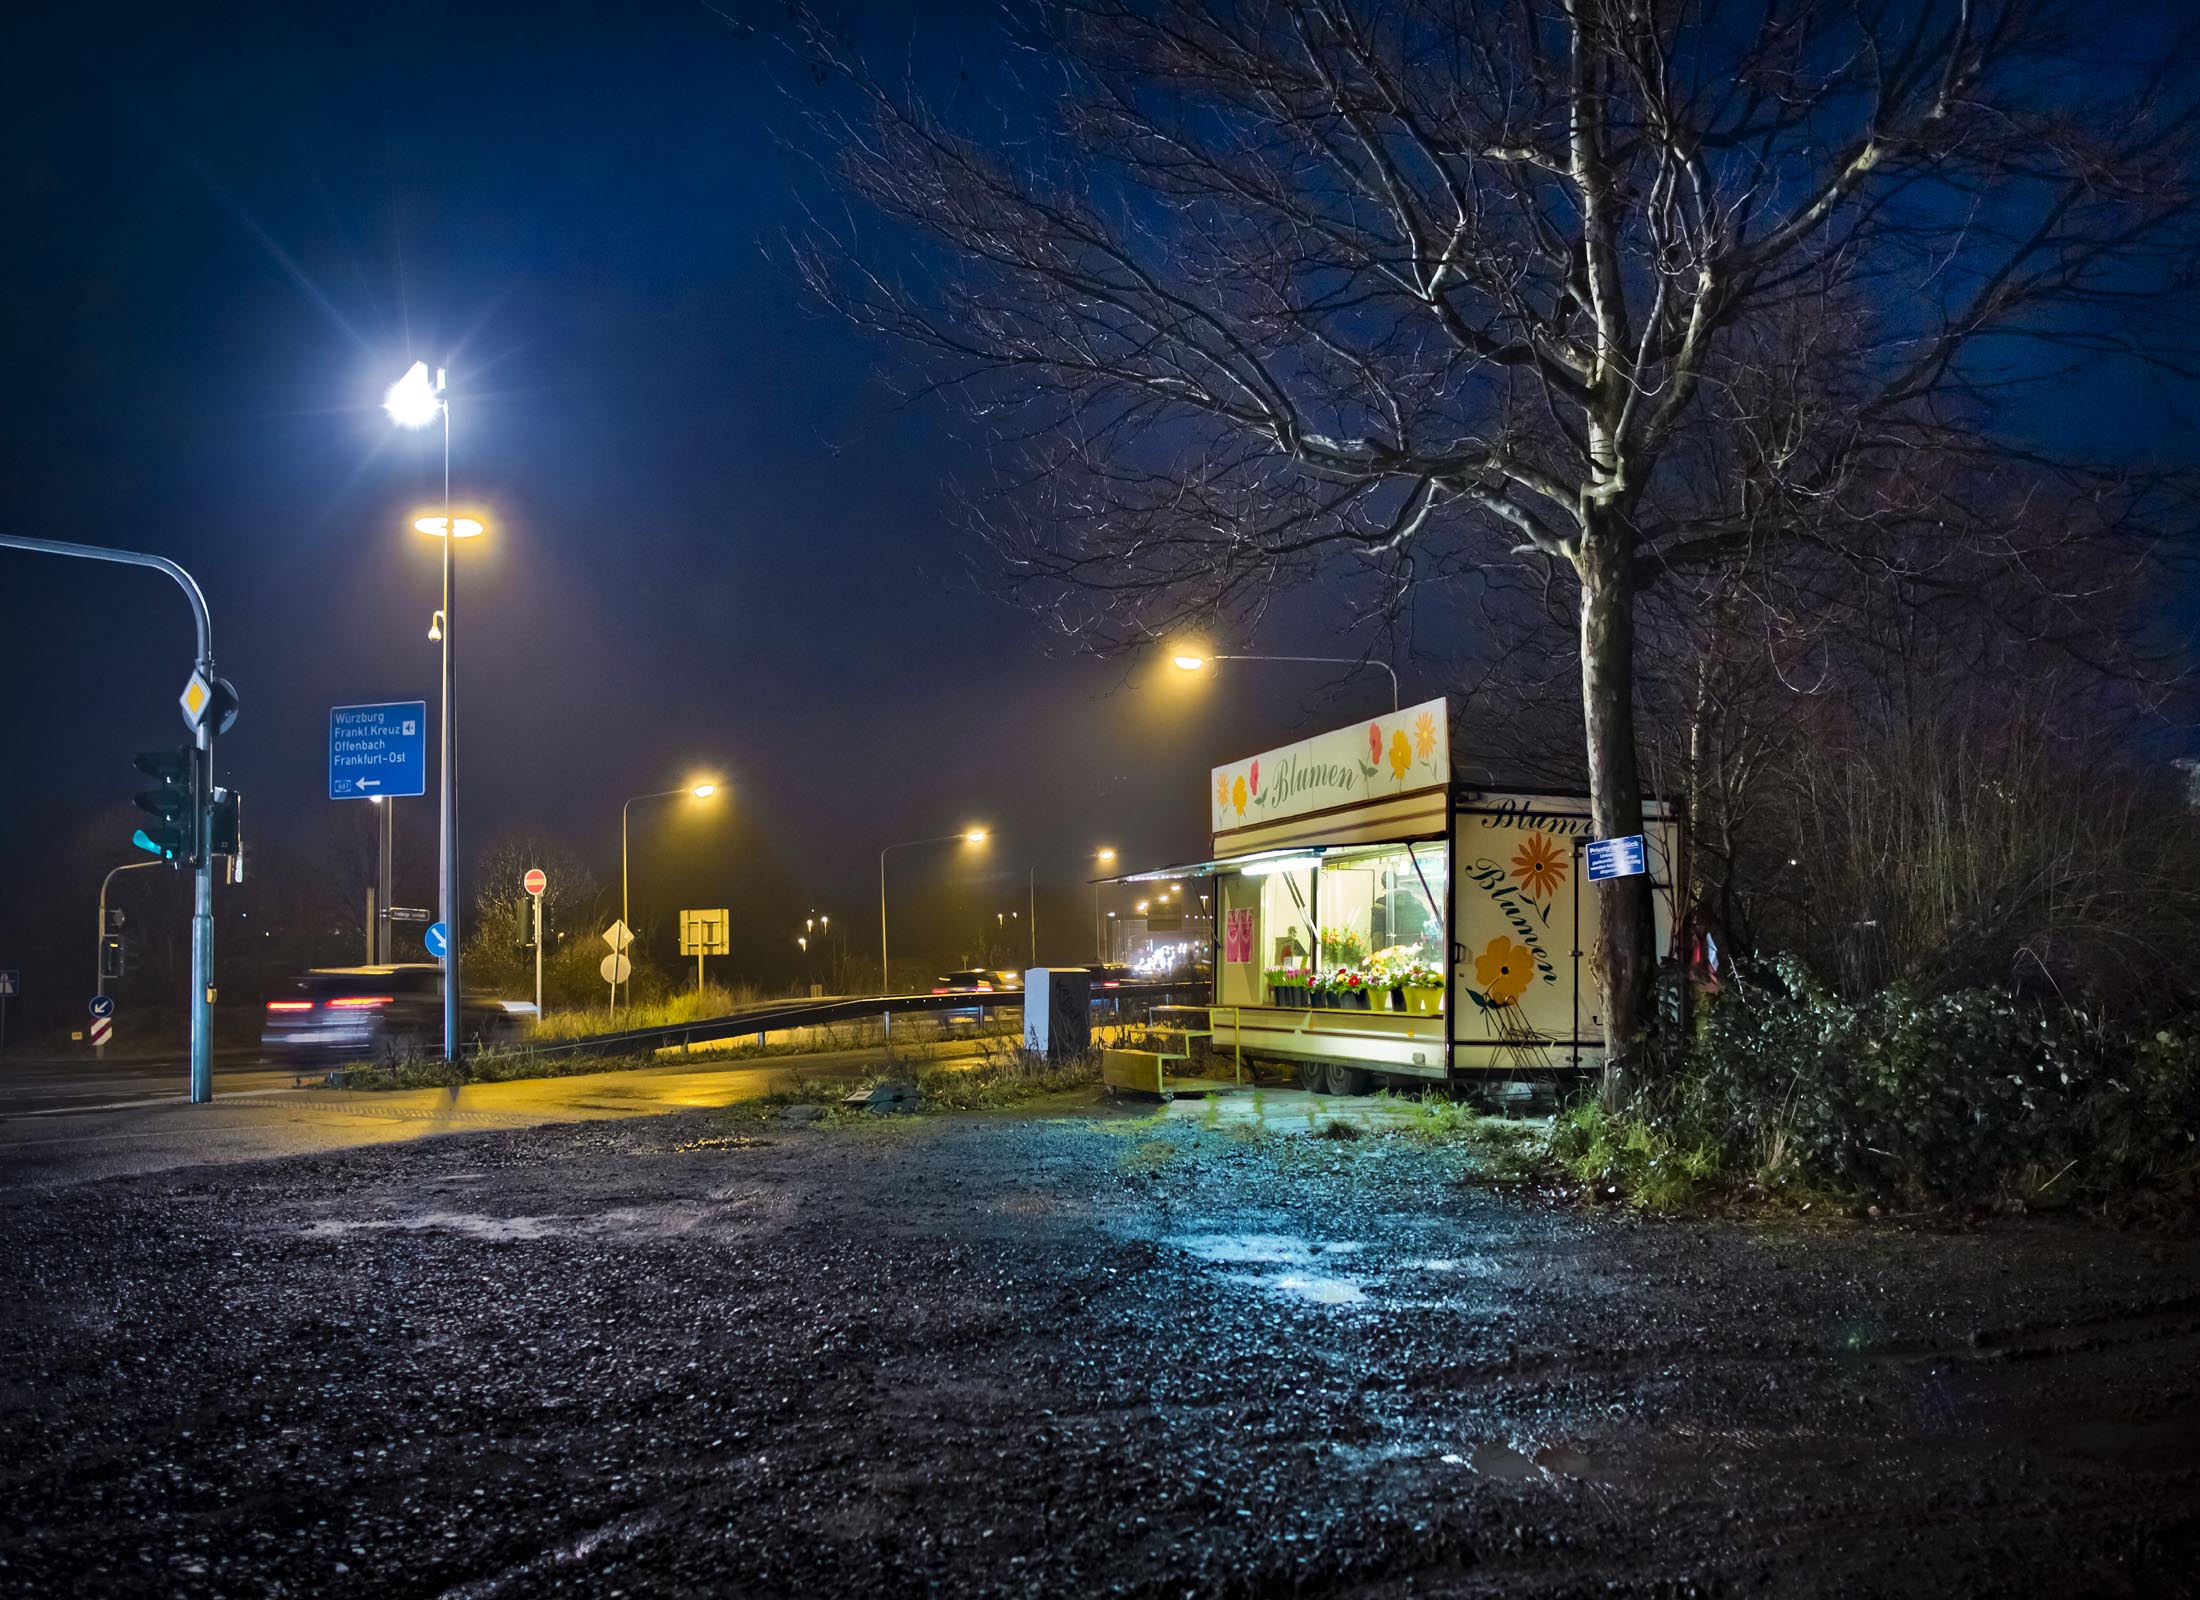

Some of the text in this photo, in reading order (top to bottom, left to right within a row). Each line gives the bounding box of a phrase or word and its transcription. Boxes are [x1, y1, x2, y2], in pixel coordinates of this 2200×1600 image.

[335, 712, 385, 725] Würzburg
[371, 725, 401, 736] Kreuz
[334, 739, 385, 752] Offenbach
[334, 752, 406, 766] Frankfurt-Ost
[1272, 753, 1358, 808] Blumen
[1465, 858, 1557, 986] Blumen
